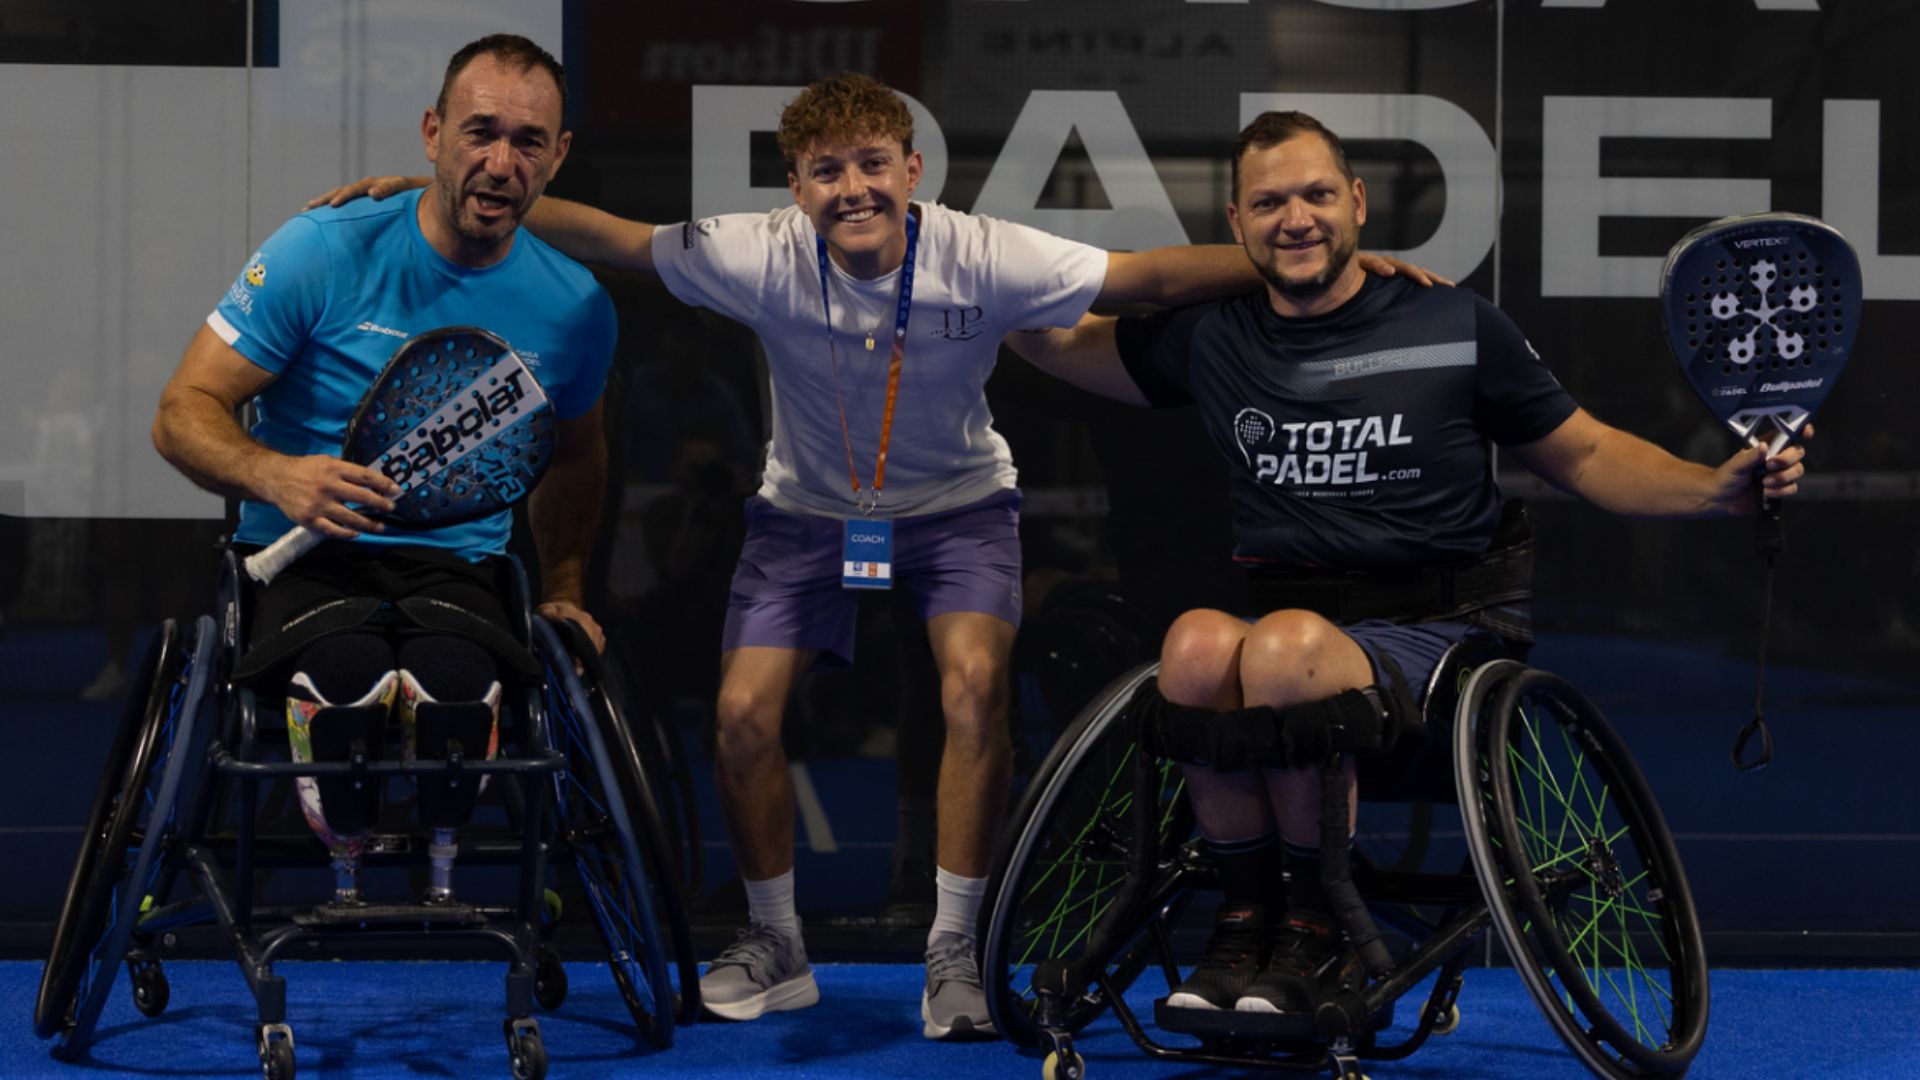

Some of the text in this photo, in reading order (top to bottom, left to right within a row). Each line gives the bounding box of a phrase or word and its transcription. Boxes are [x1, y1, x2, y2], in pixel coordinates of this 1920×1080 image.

[1734, 236, 1783, 249] VERTEX
[1759, 378, 1824, 393] Bullpadel
[1281, 413, 1413, 452] TOTAL
[851, 534, 885, 544] COACH
